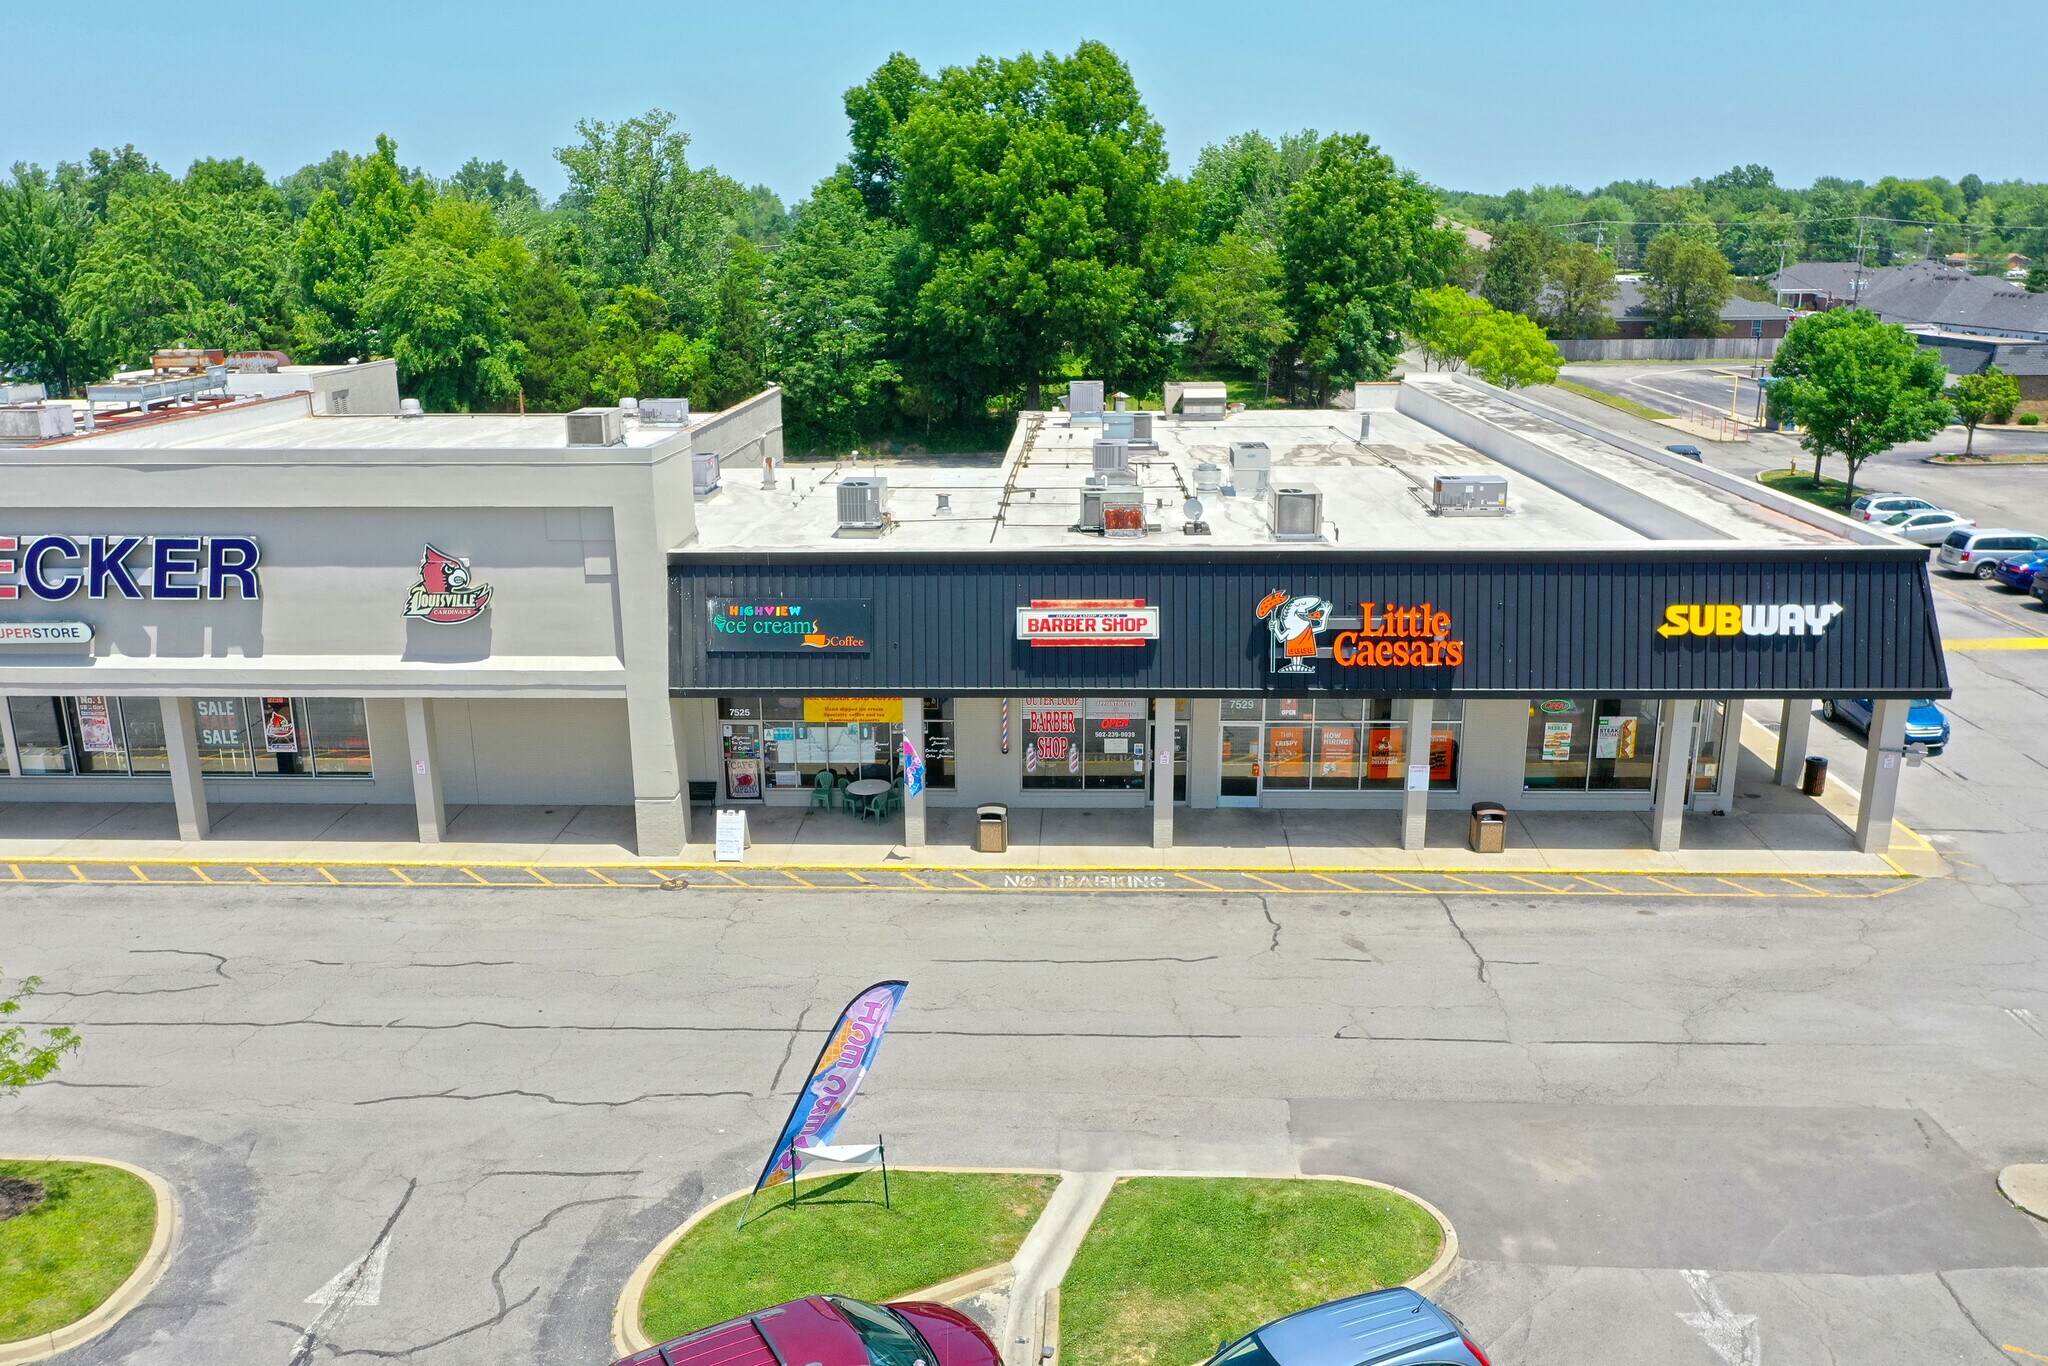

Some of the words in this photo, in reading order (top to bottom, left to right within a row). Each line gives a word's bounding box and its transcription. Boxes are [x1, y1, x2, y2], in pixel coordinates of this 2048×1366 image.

[403, 585, 477, 615] LOUISVILLE
[729, 605, 802, 617] HIGHVIEW
[1028, 618, 1097, 632] BARBER
[1101, 617, 1148, 632] SHOP
[1360, 602, 1451, 637] Little
[1656, 601, 1844, 639] SUBWAY
[830, 636, 864, 647] Coffee
[1333, 631, 1463, 667] Caesars
[198, 701, 235, 716] SALE
[1230, 700, 1254, 709] 7529
[1544, 702, 1566, 710] OPEN
[729, 708, 751, 717] 7525
[1029, 711, 1076, 733] BARBER
[1101, 717, 1131, 729] OPEN
[203, 730, 239, 744] SALE
[1037, 736, 1069, 759] SHOP
[1003, 875, 1036, 888] NO
[1059, 875, 1166, 888] PARKING
